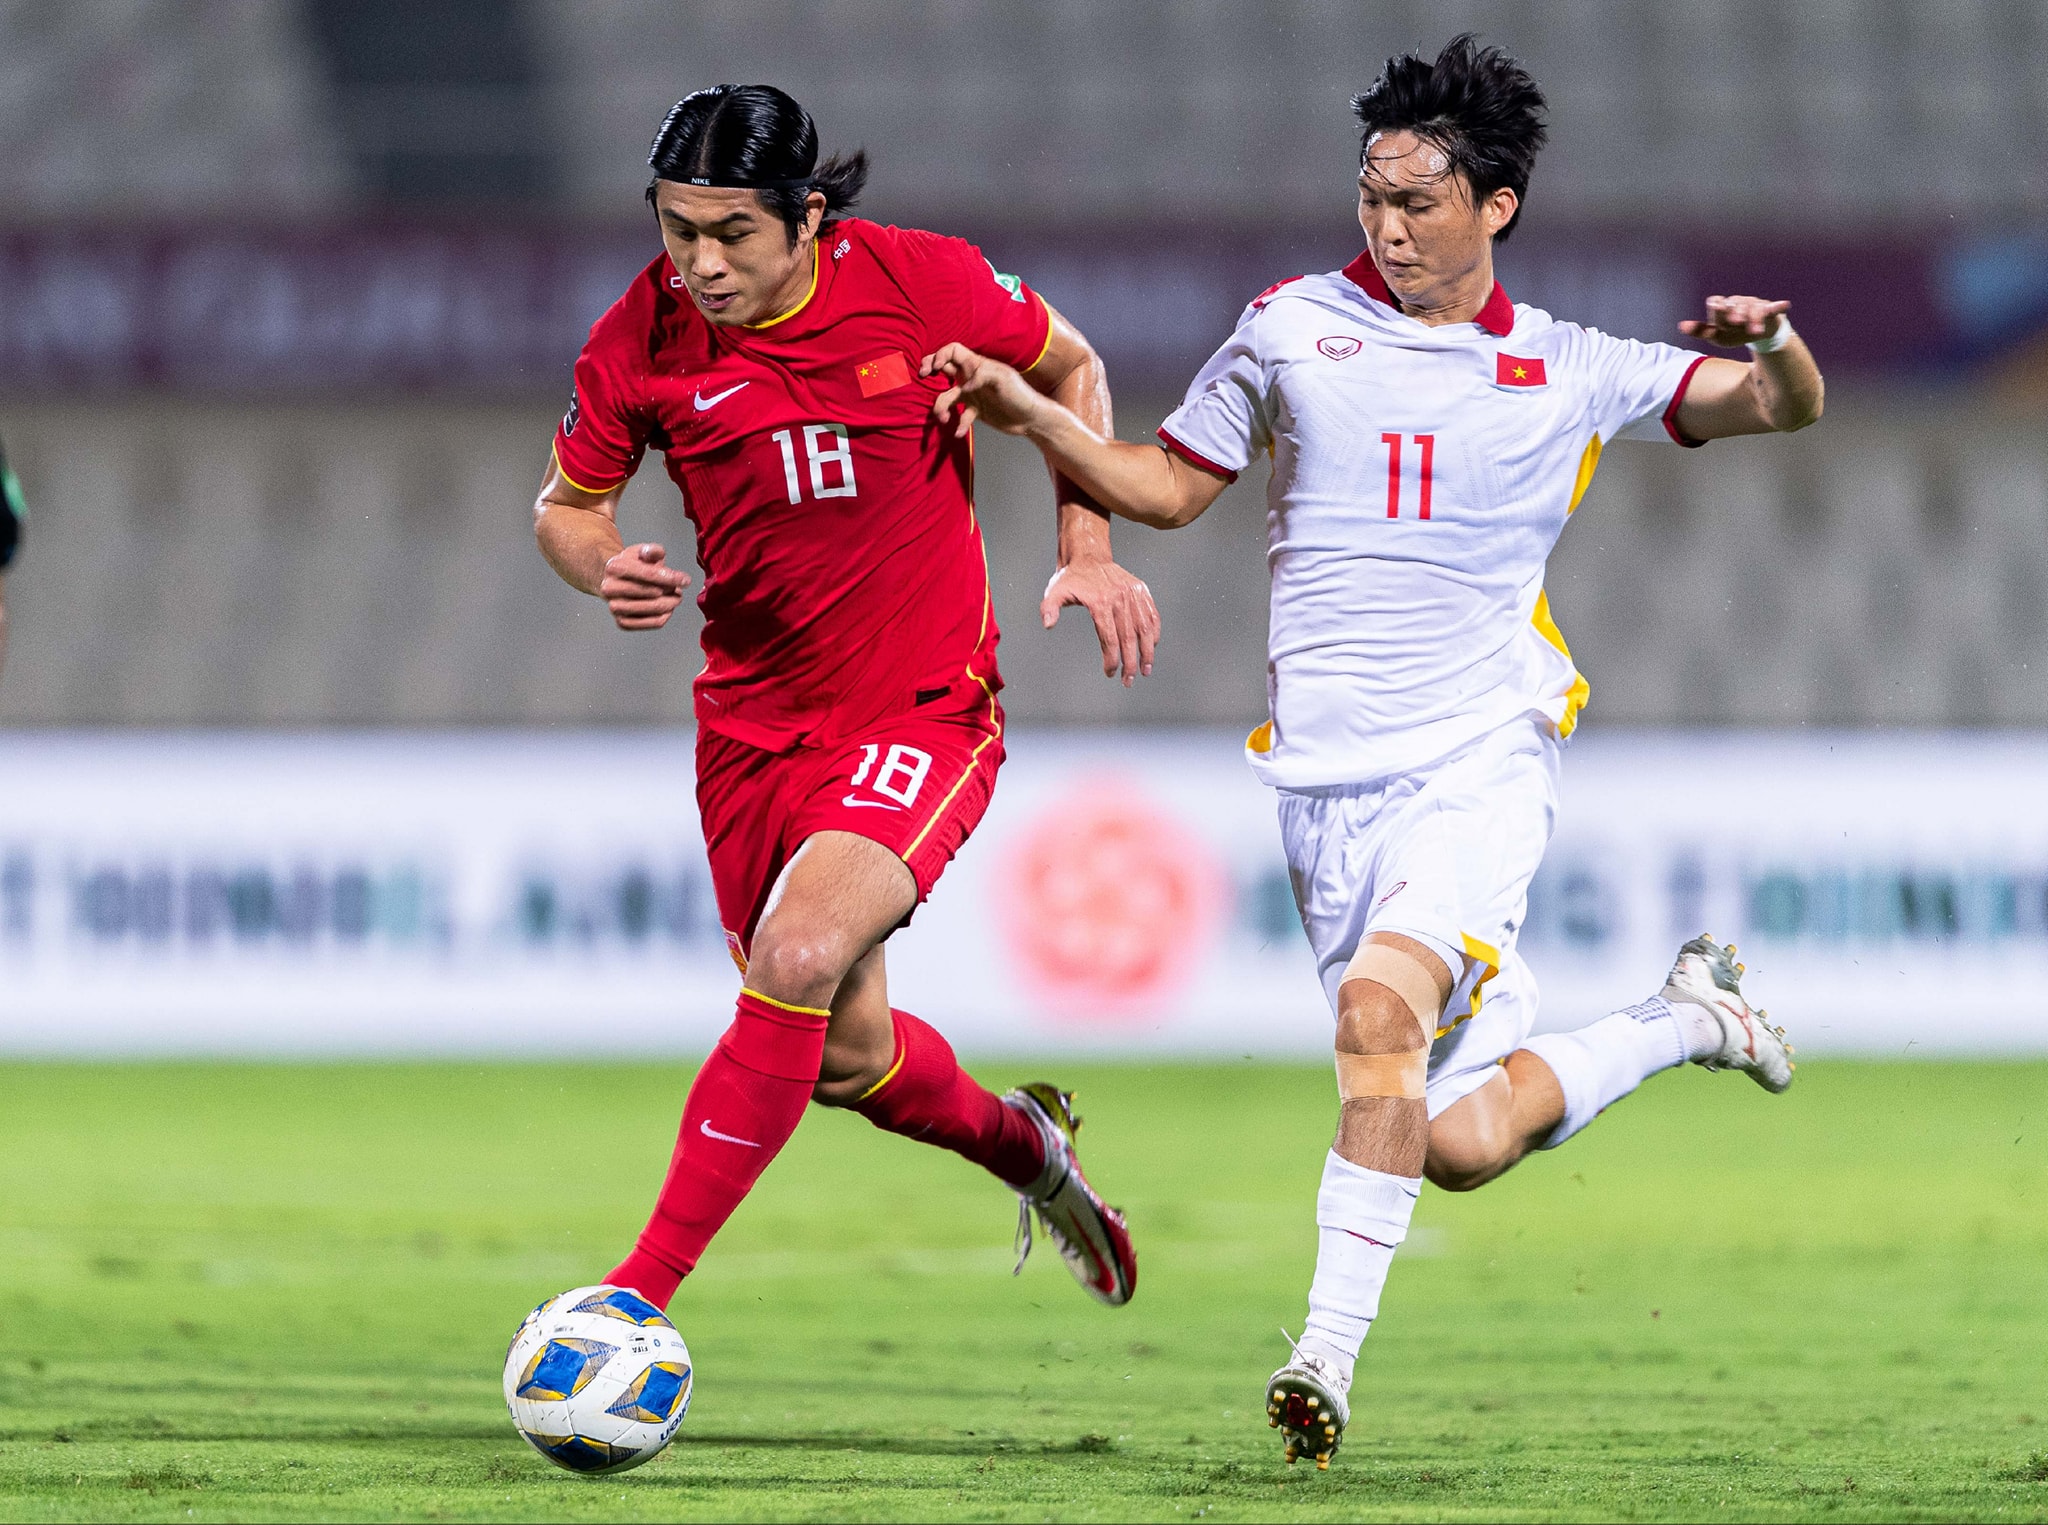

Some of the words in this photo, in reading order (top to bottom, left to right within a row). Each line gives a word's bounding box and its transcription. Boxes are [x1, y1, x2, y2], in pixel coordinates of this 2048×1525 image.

[691, 177, 710, 186] NIKE
[833, 239, 851, 259] 中国
[772, 423, 858, 505] 18
[1381, 433, 1434, 520] 11
[850, 743, 932, 809] 18
